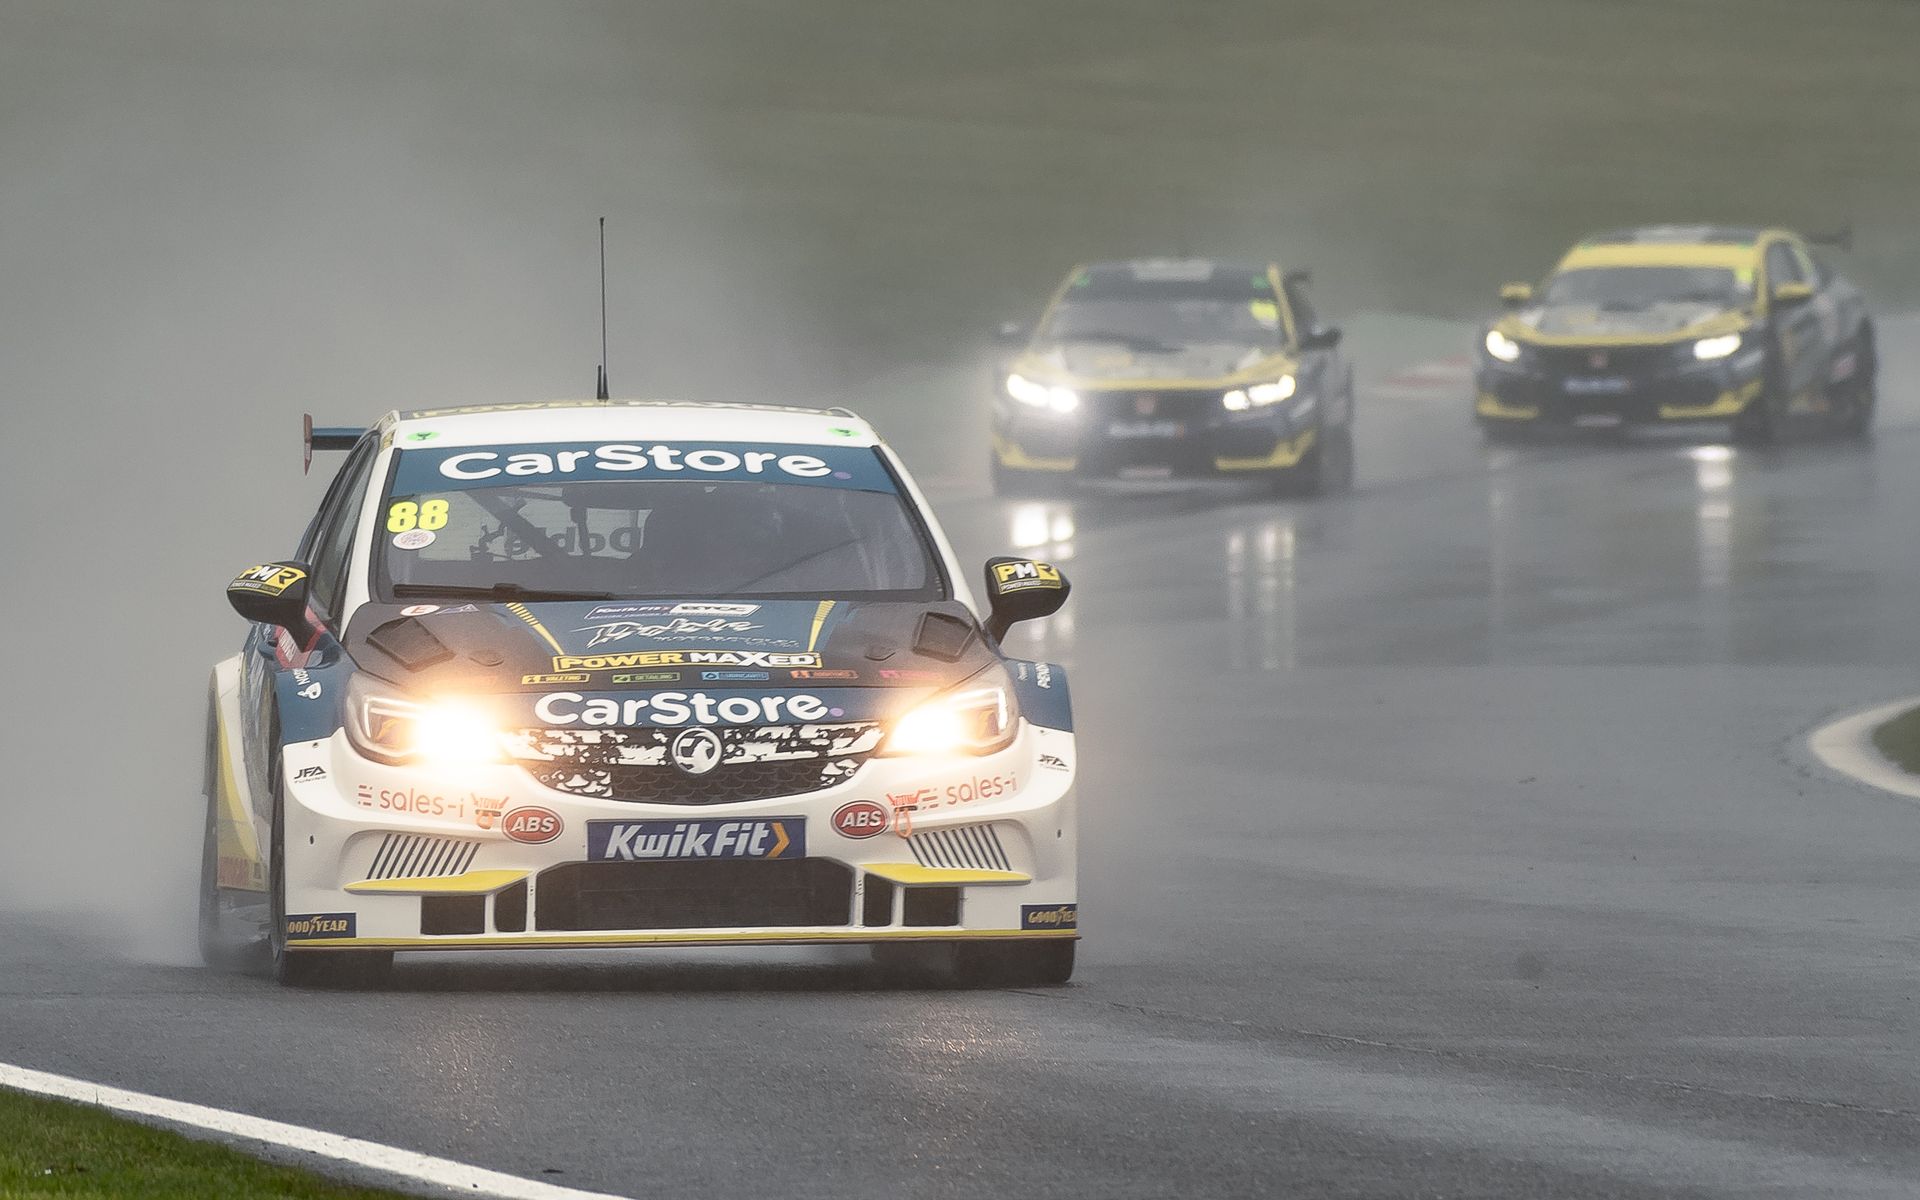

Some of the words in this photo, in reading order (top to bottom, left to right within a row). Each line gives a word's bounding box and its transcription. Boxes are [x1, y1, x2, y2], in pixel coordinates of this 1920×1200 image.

[387, 500, 449, 533] 88
[239, 565, 297, 584] PMR
[559, 653, 684, 669] POWER
[690, 651, 816, 668] MAXED
[294, 766, 326, 779] JFA
[947, 772, 1018, 805] sales-i
[379, 788, 464, 817] sales-i
[511, 817, 555, 833] ABS
[841, 810, 883, 828] ABS
